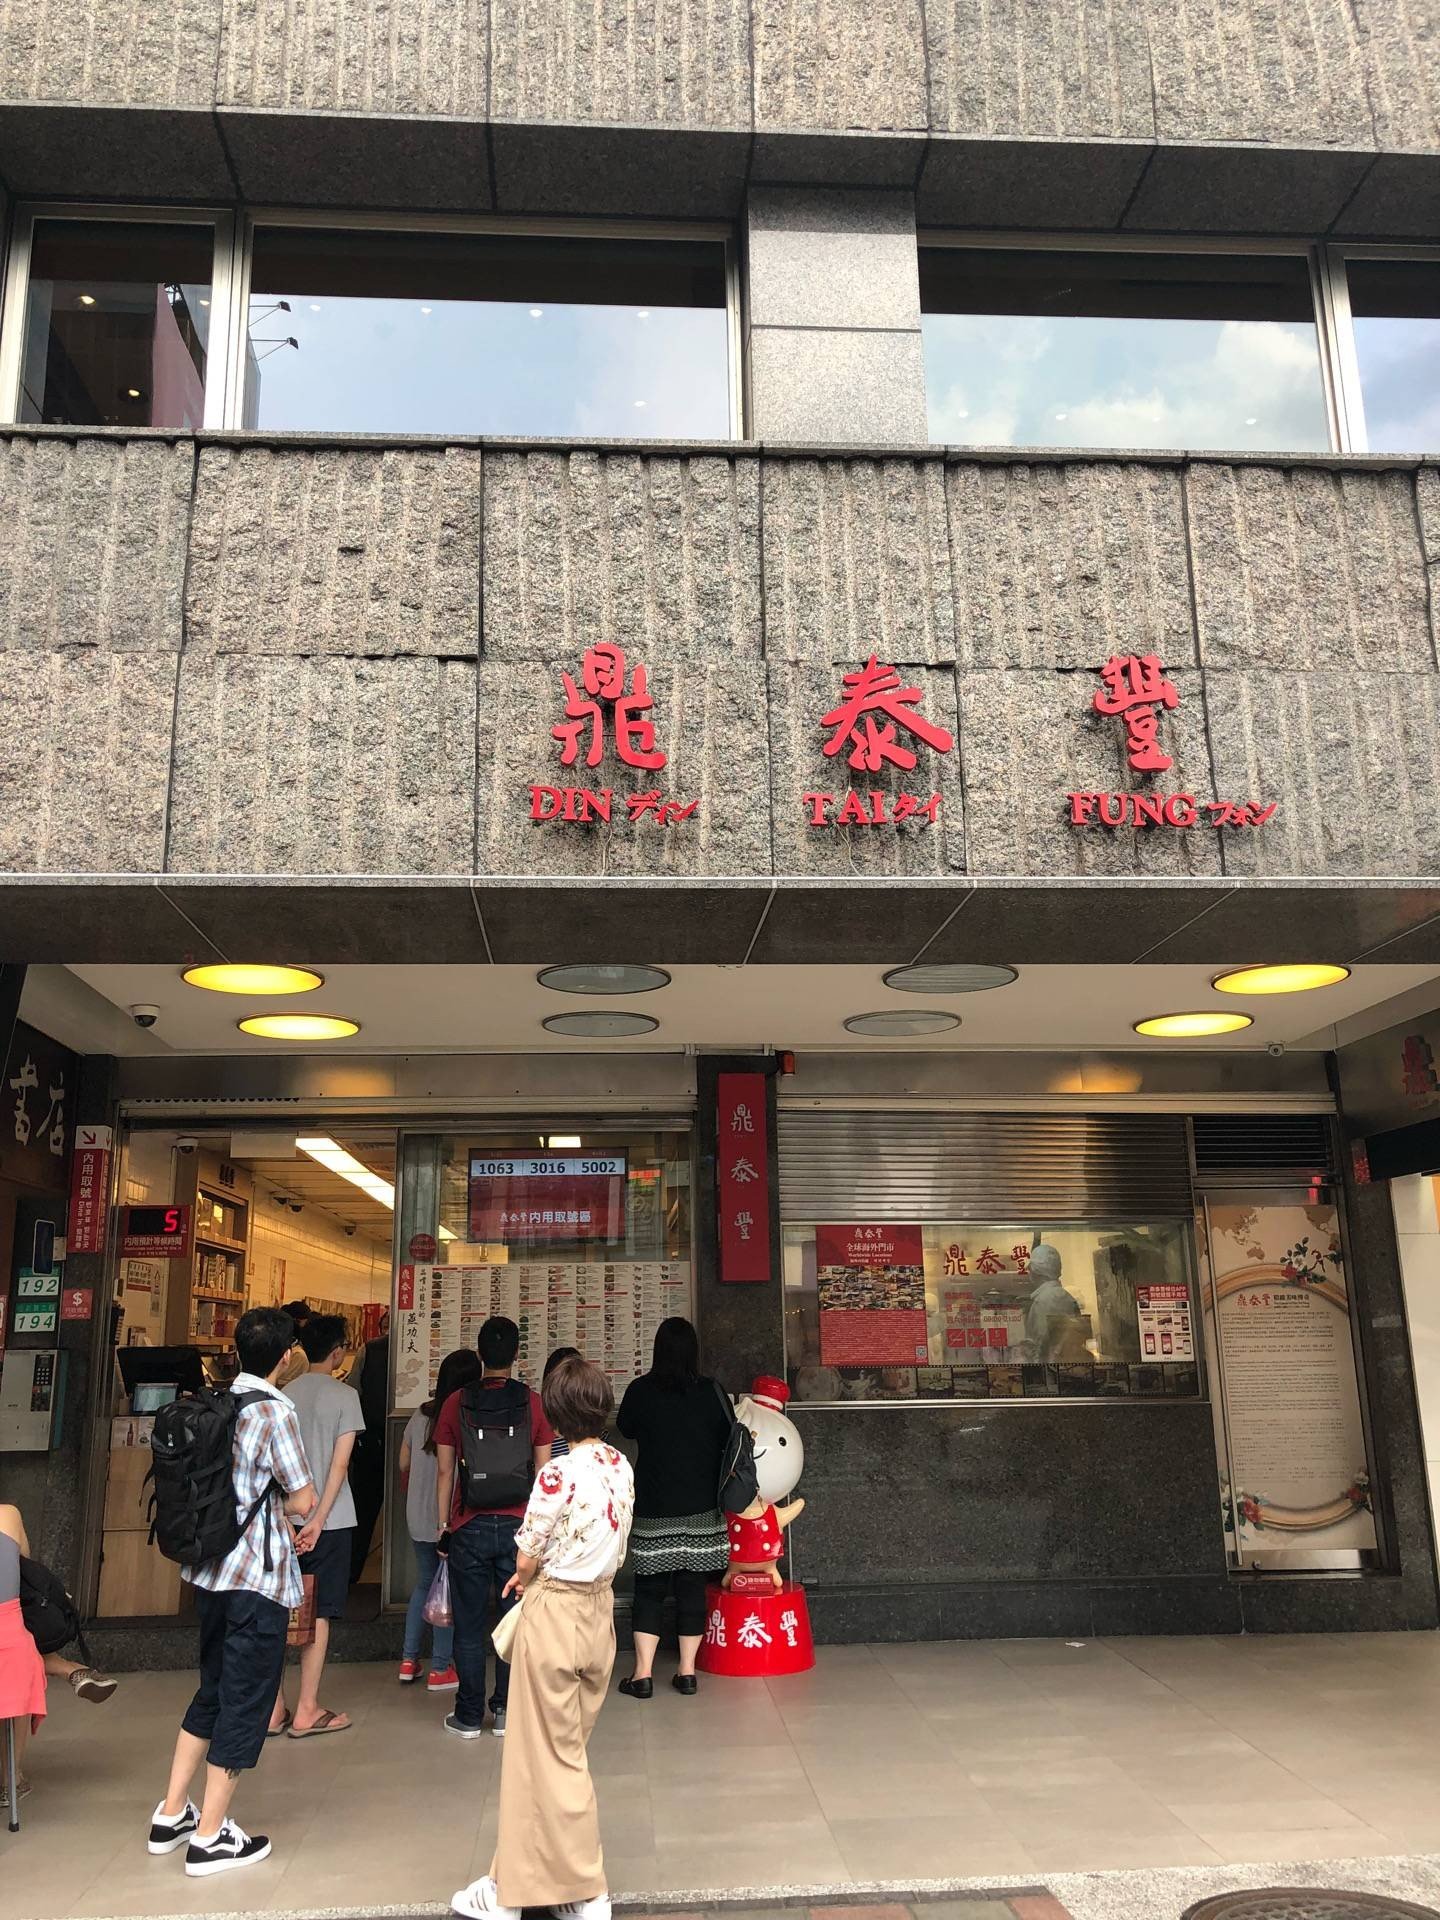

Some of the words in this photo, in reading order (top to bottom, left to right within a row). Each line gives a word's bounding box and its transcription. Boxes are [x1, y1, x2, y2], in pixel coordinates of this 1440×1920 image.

[528, 785, 613, 823] DIN
[625, 789, 700, 826] ディン
[802, 790, 888, 826] TAI
[891, 791, 943, 824] タイ
[1067, 791, 1199, 828] FUNG
[1207, 801, 1278, 828] フォン
[479, 1163, 514, 1175] 1063
[530, 1162, 566, 1174] 3016
[581, 1161, 617, 1173] 5002
[730, 1103, 759, 1240] 鼎泰豐
[164, 1210, 178, 1232] 5
[943, 1244, 1030, 1276] 鼎泰豐
[23, 1279, 57, 1293] 192
[18, 1315, 54, 1329] 194
[706, 1609, 798, 1648] 鼎泰豐
